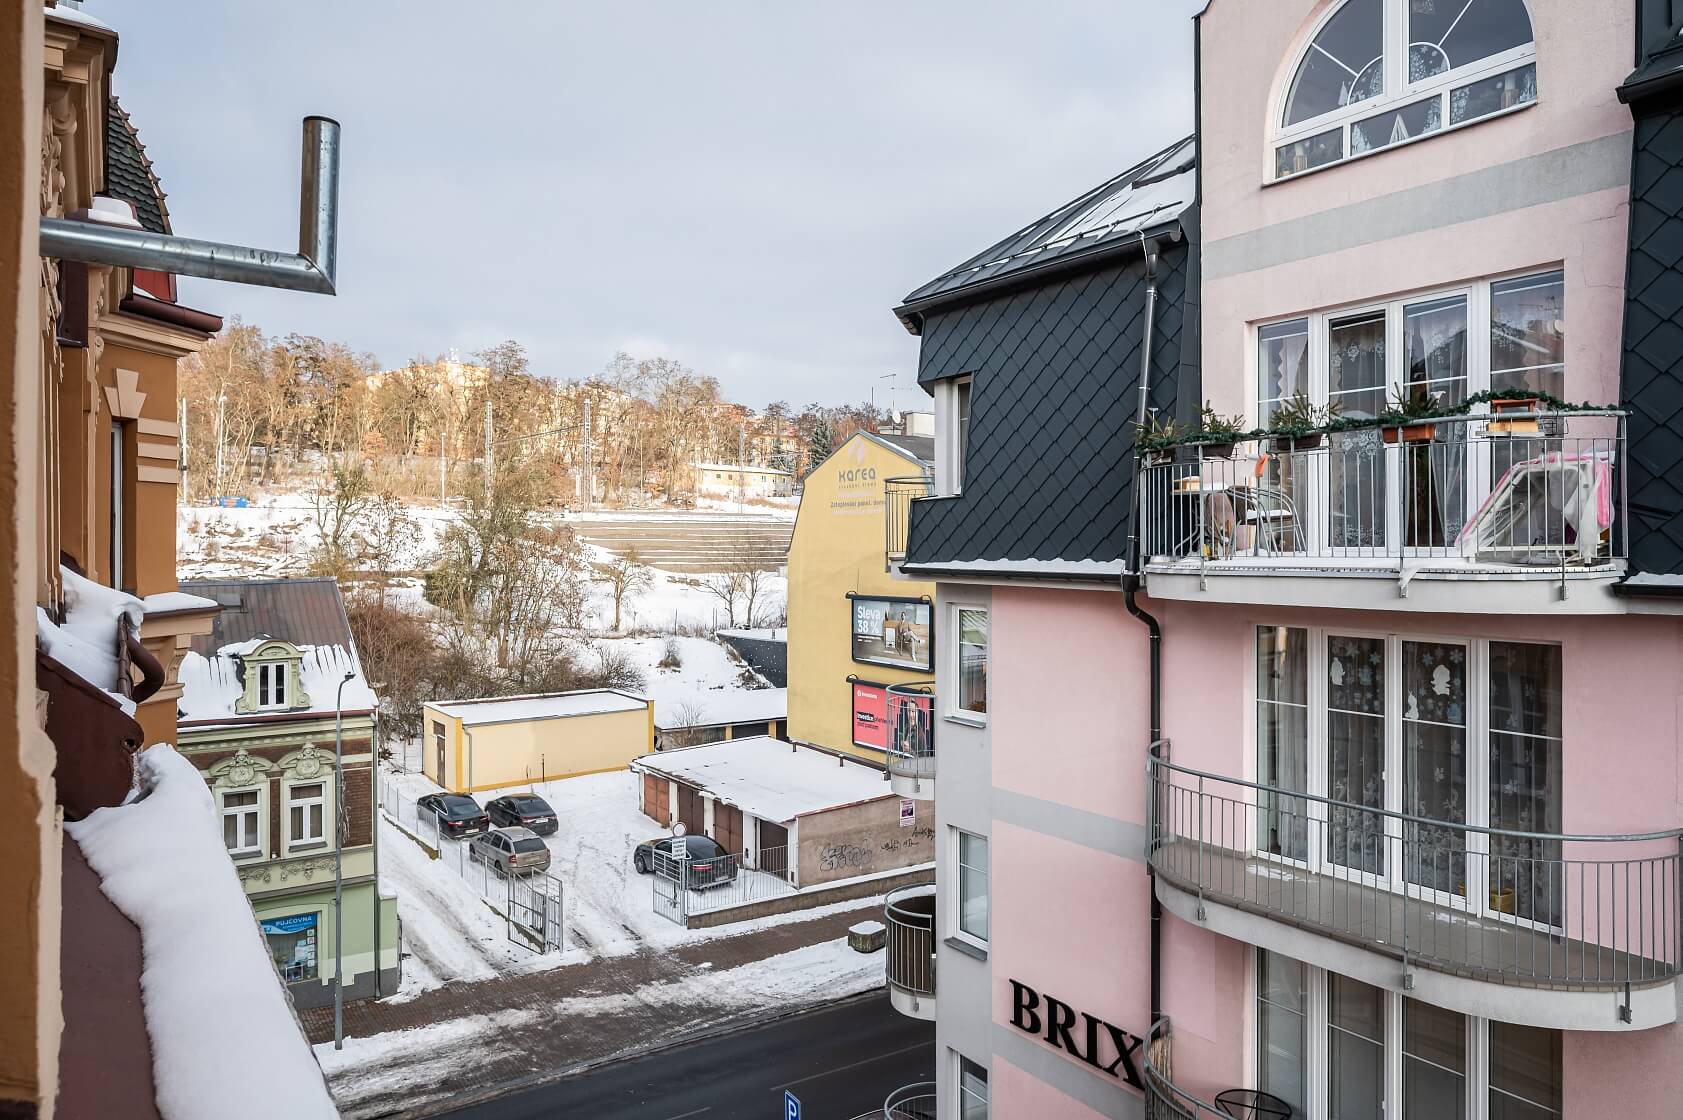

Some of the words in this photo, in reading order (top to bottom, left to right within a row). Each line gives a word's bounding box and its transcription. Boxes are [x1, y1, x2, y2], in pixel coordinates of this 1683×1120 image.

[857, 605, 881, 620] Sleva
[857, 619, 869, 634] 38
[1009, 978, 1146, 1092] BRIX
[788, 1098, 797, 1120] P
